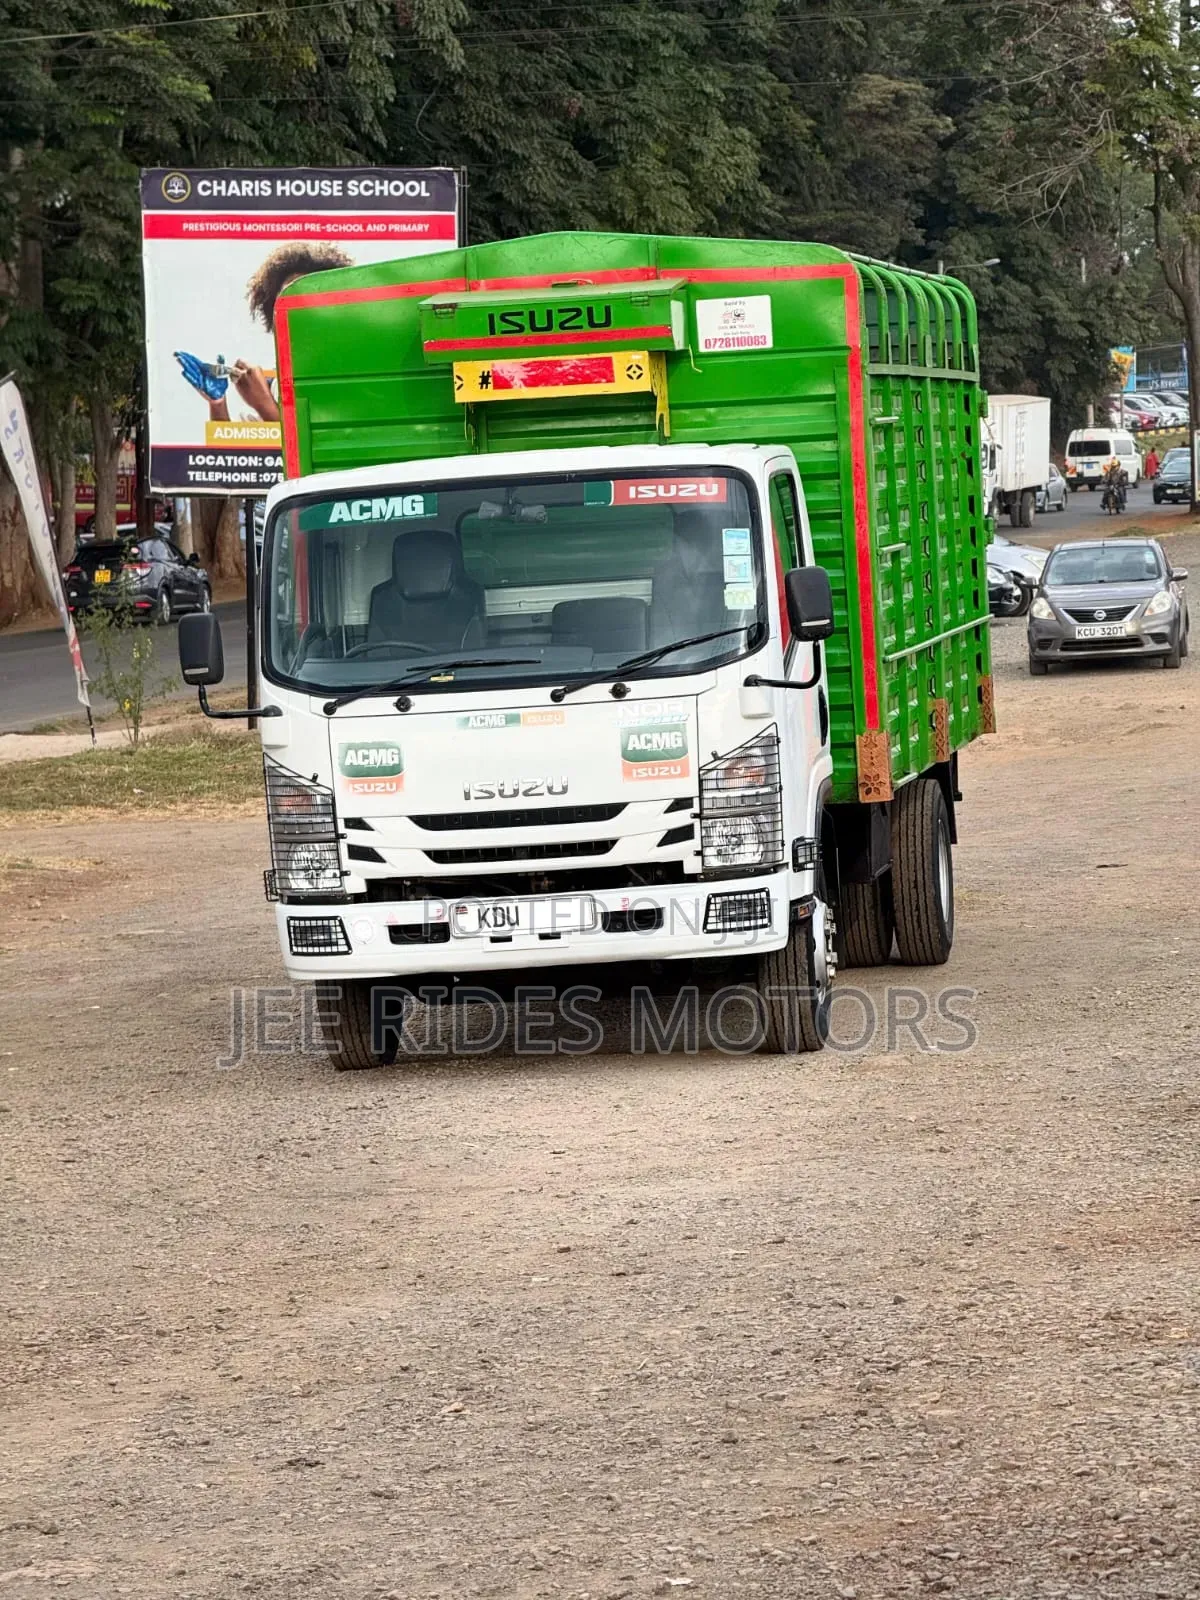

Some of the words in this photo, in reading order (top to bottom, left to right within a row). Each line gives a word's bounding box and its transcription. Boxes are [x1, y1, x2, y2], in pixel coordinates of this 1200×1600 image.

[197, 179, 272, 197] CHARIS
[276, 179, 343, 197] HOUSE
[347, 179, 430, 197] SCHOOL
[183, 222, 241, 232] PRESTIGIOUS
[243, 222, 302, 233] MONTESSORI
[304, 223, 364, 233] PRE-SCHOOL
[366, 223, 386, 233] AND
[388, 223, 430, 233] PRIMARY
[488, 304, 612, 336] ISUZU
[188, 454, 262, 467] LOCATION:
[264, 456, 284, 467] GA
[187, 470, 257, 482] TELEPHONE
[629, 483, 718, 499] ISUZU
[328, 494, 425, 523] ACMG
[1077, 627, 1096, 637] KCU
[468, 713, 506, 728] ACMG
[627, 731, 683, 751] ACMG
[344, 748, 400, 767] ACMG
[631, 765, 682, 778] ISUZU
[348, 782, 397, 793] ISUZU
[462, 776, 569, 801] ISUZU
[478, 905, 520, 929] KDU
